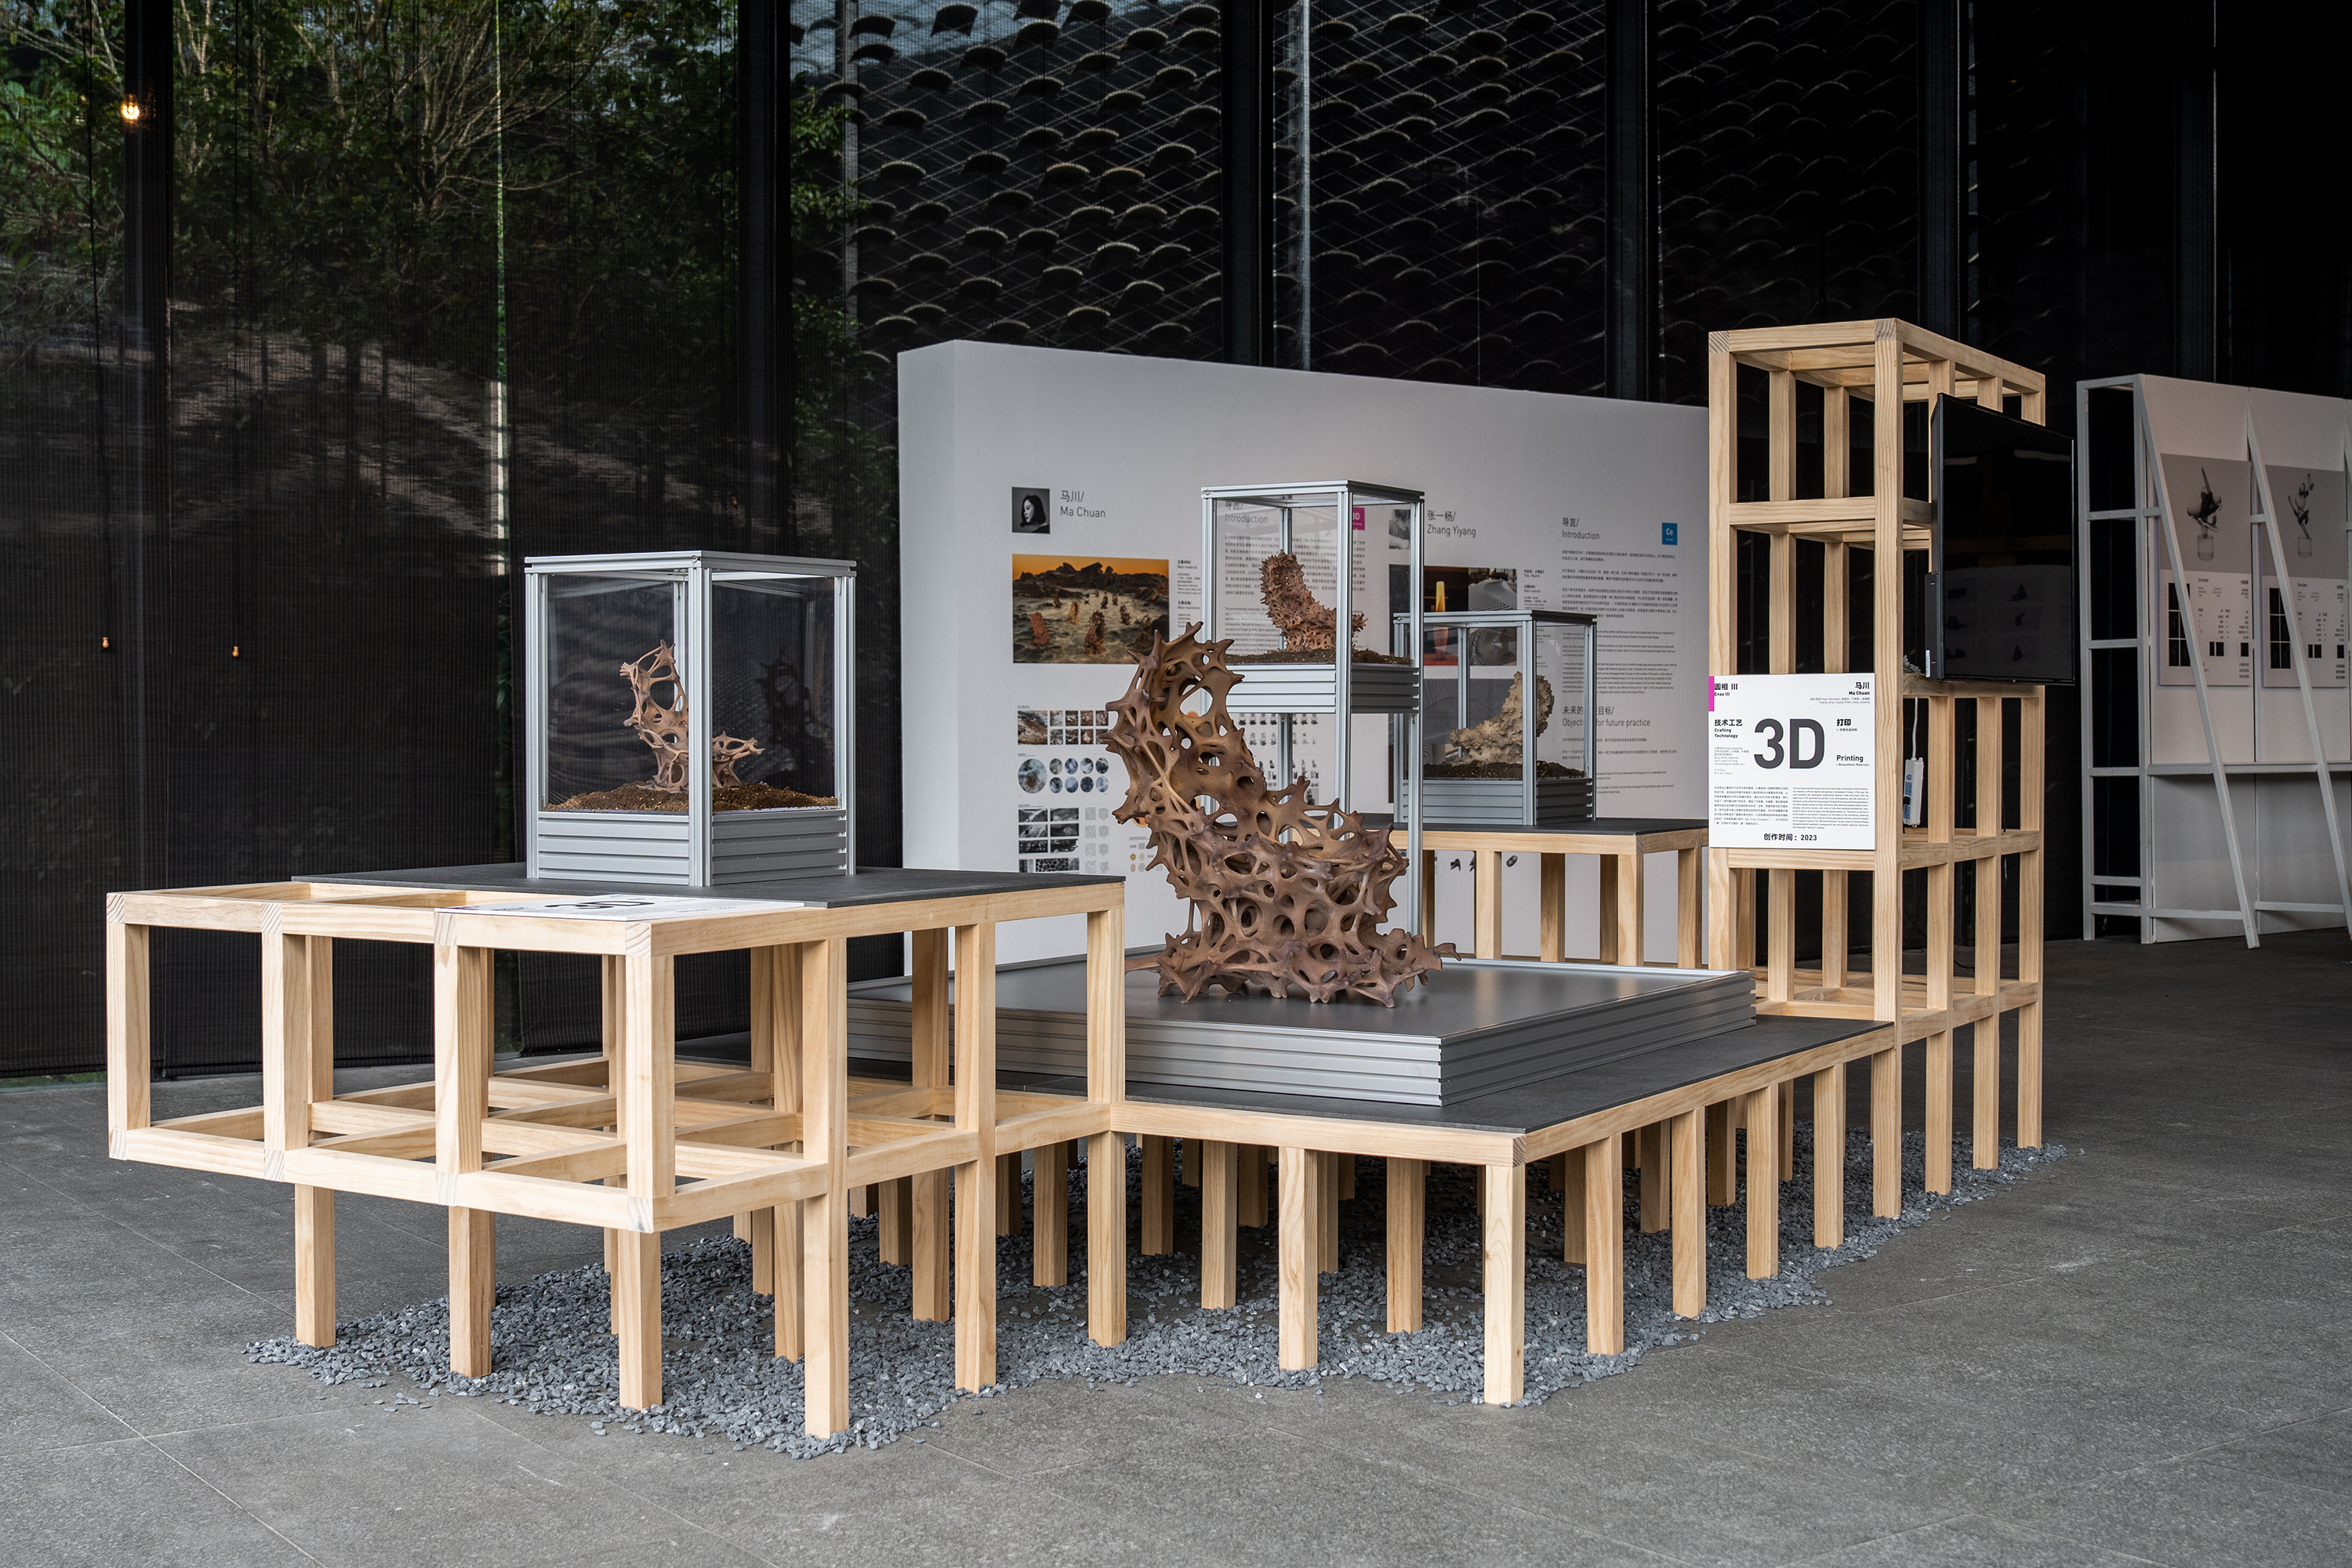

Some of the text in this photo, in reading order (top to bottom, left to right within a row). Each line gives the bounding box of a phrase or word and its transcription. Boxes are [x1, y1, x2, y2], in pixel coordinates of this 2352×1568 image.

[1060, 490, 1085, 503] 马川/
[1060, 506, 1106, 518] Ma Chuan
[1225, 514, 1269, 524] Introduction
[1427, 524, 1476, 539] Zhang Yiyang
[1562, 529, 1600, 540] Introduction
[1665, 528, 1674, 536] Ce
[1855, 681, 1870, 690] 马川
[1562, 706, 1615, 717] 未来的目标/
[1606, 718, 1624, 728] future
[1626, 719, 1650, 729] practice
[1836, 718, 1852, 727] 打印
[1754, 718, 1825, 769] 3D
[1836, 754, 1864, 763] Printing
